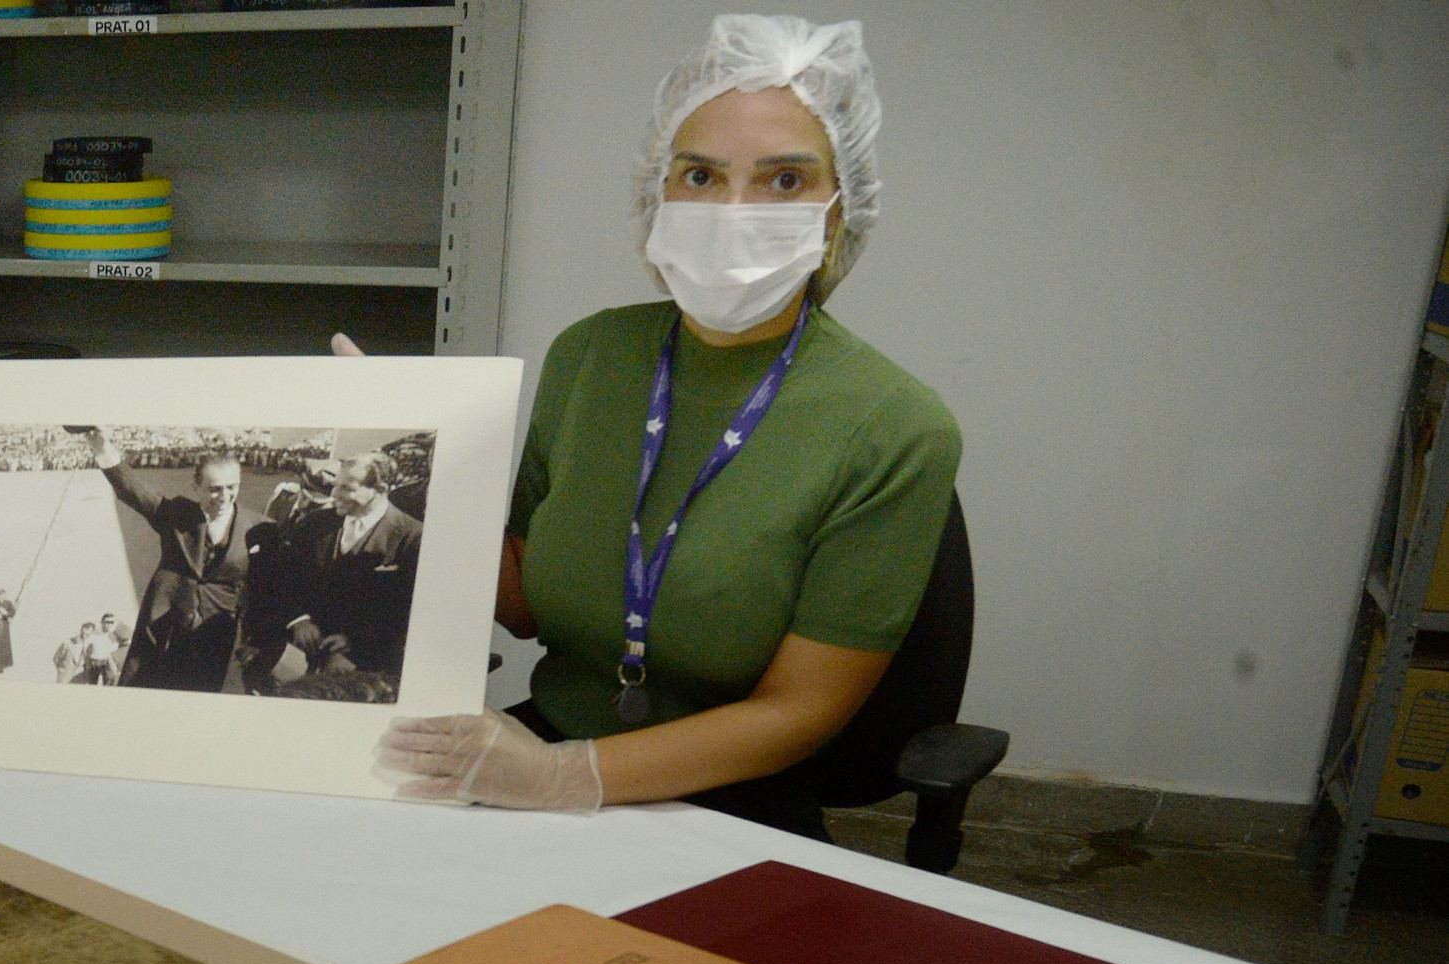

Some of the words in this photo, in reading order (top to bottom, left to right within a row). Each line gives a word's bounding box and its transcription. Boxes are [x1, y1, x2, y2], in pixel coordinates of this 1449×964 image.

[95, 21, 132, 33] PRAT.
[135, 20, 150, 32] 01
[97, 265, 132, 277] PRAT.
[135, 266, 152, 278] 02
